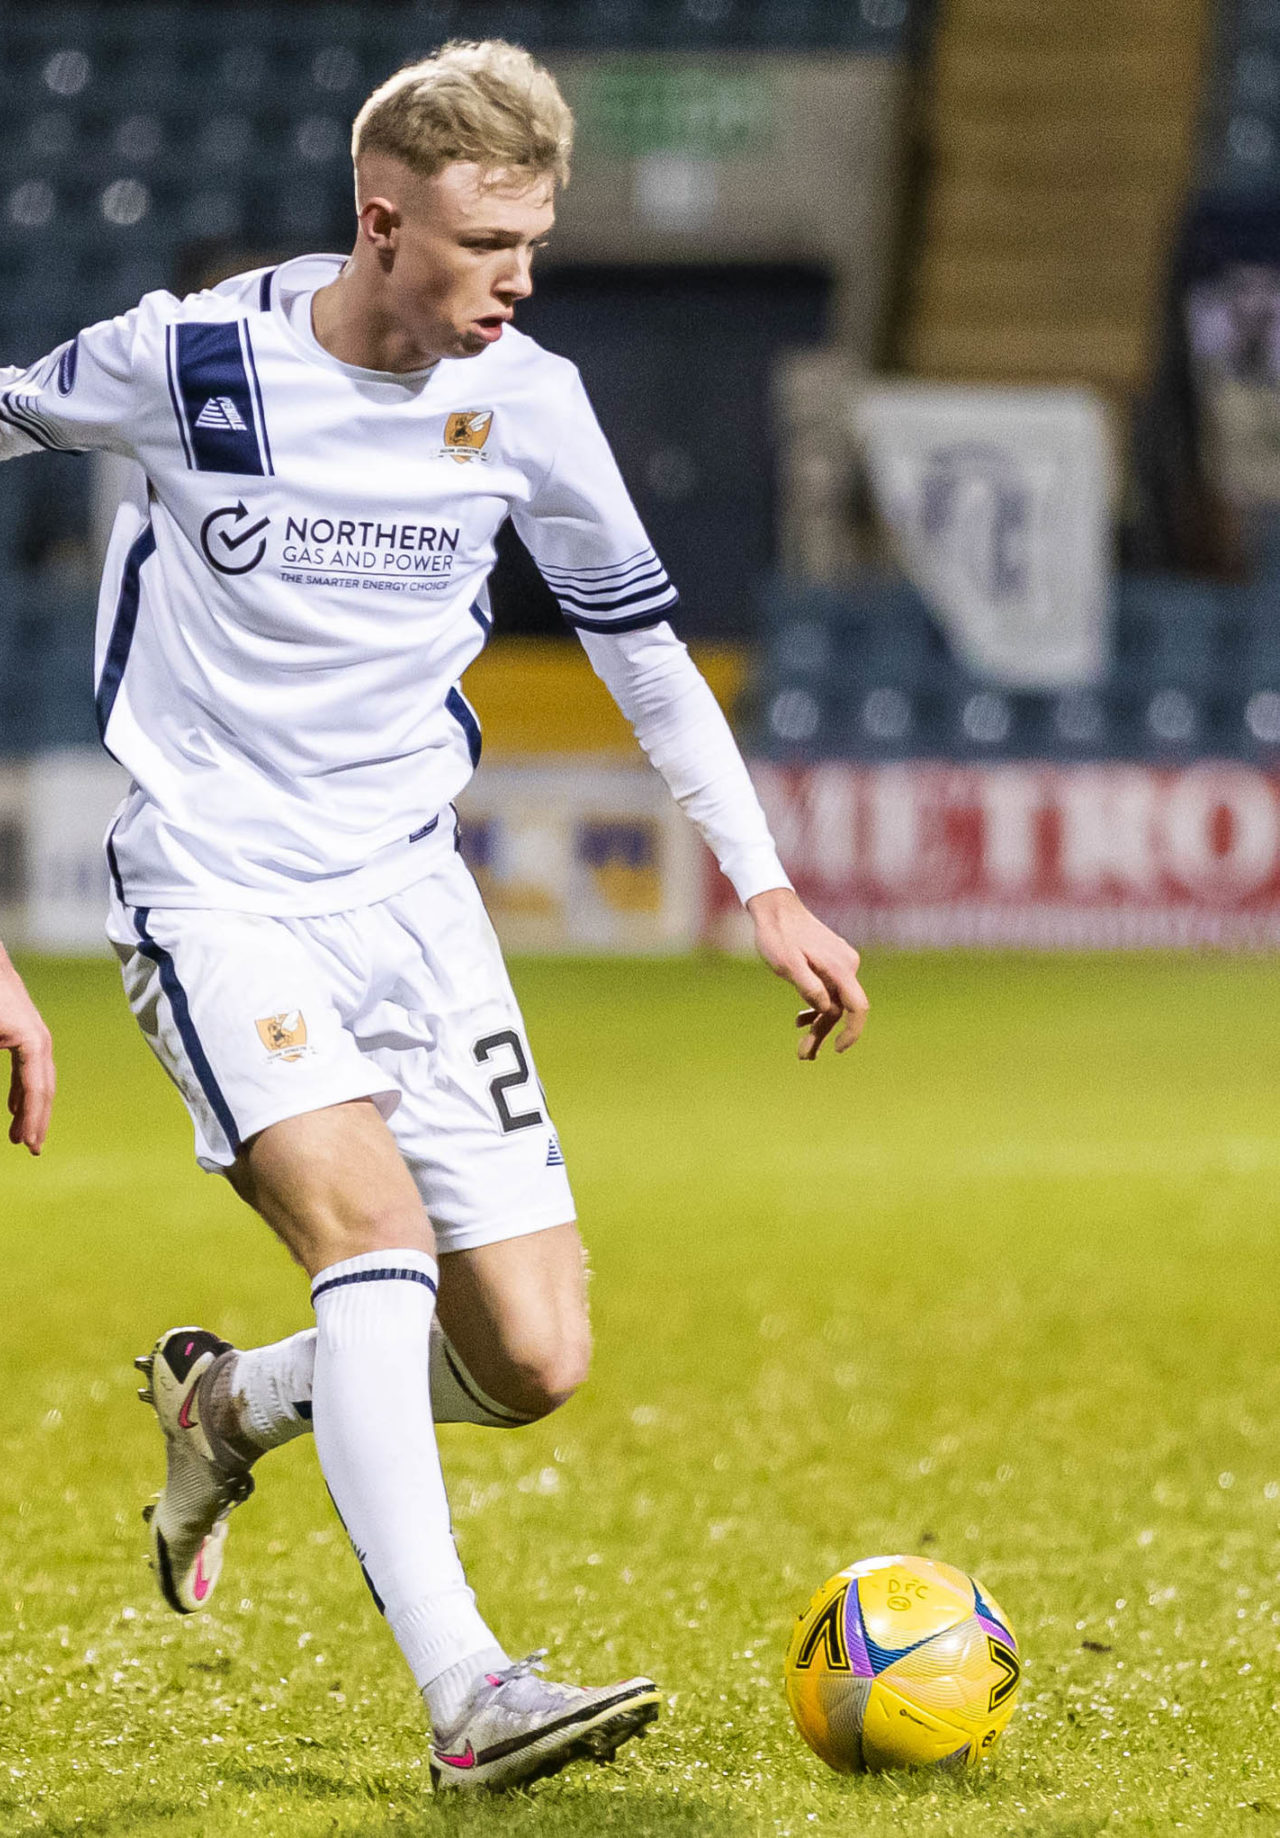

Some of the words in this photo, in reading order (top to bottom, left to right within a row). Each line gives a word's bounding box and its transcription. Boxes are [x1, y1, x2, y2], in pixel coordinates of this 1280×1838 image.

[284, 516, 460, 551] NORTHERN
[282, 546, 324, 565] GAS
[329, 549, 377, 569] AND
[383, 553, 453, 572] POWER
[280, 572, 303, 584] THE
[306, 575, 360, 589] SMARTER
[362, 579, 408, 592] ENERGY
[409, 581, 450, 592] CHOICE
